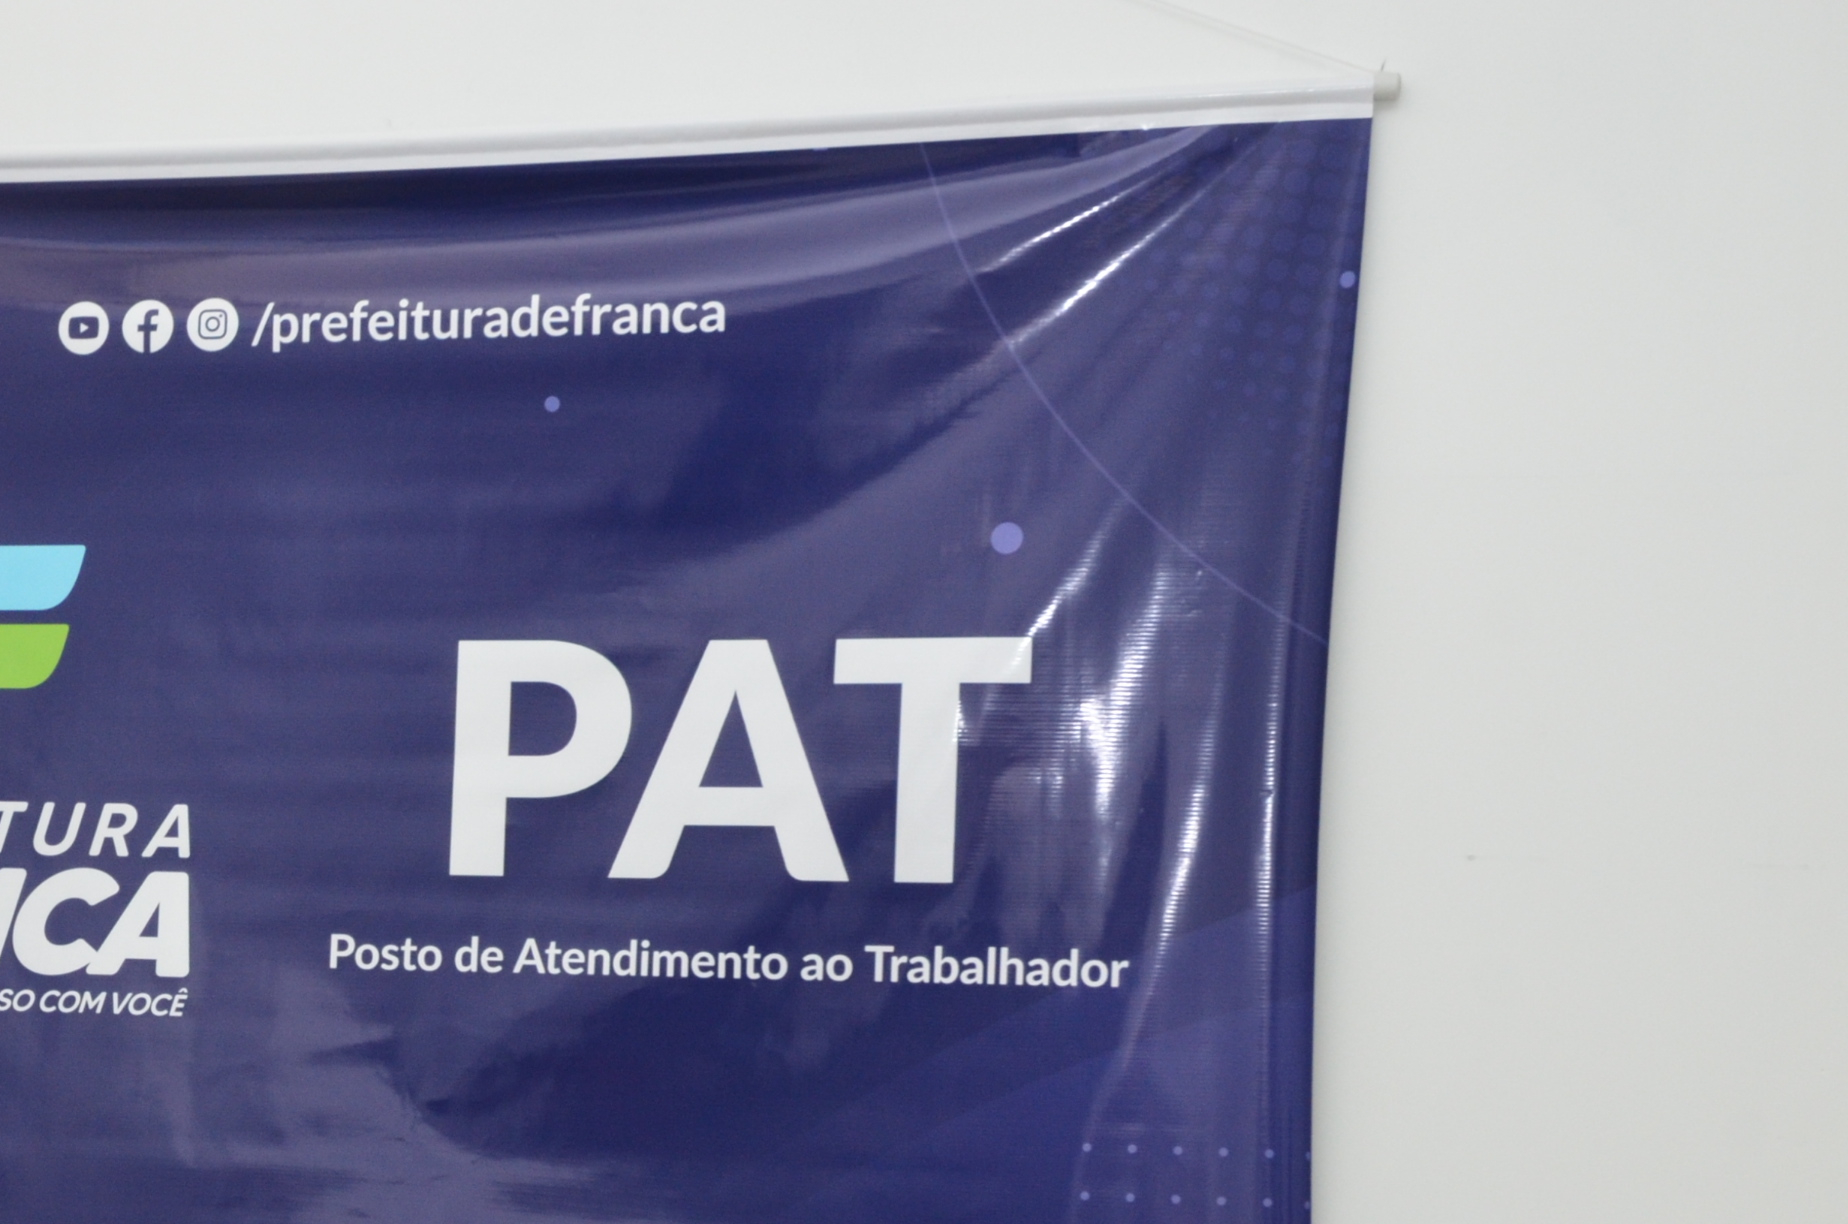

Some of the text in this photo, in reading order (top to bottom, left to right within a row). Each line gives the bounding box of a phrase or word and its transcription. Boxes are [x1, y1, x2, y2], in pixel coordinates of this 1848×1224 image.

[251, 292, 726, 353] /prefeituradefranca
[448, 636, 1033, 884] PAT
[329, 933, 1130, 988] Posto de Atendimento ao Trabalhador
[38, 989, 105, 1014] COM
[109, 987, 189, 1017] VOCÊ
